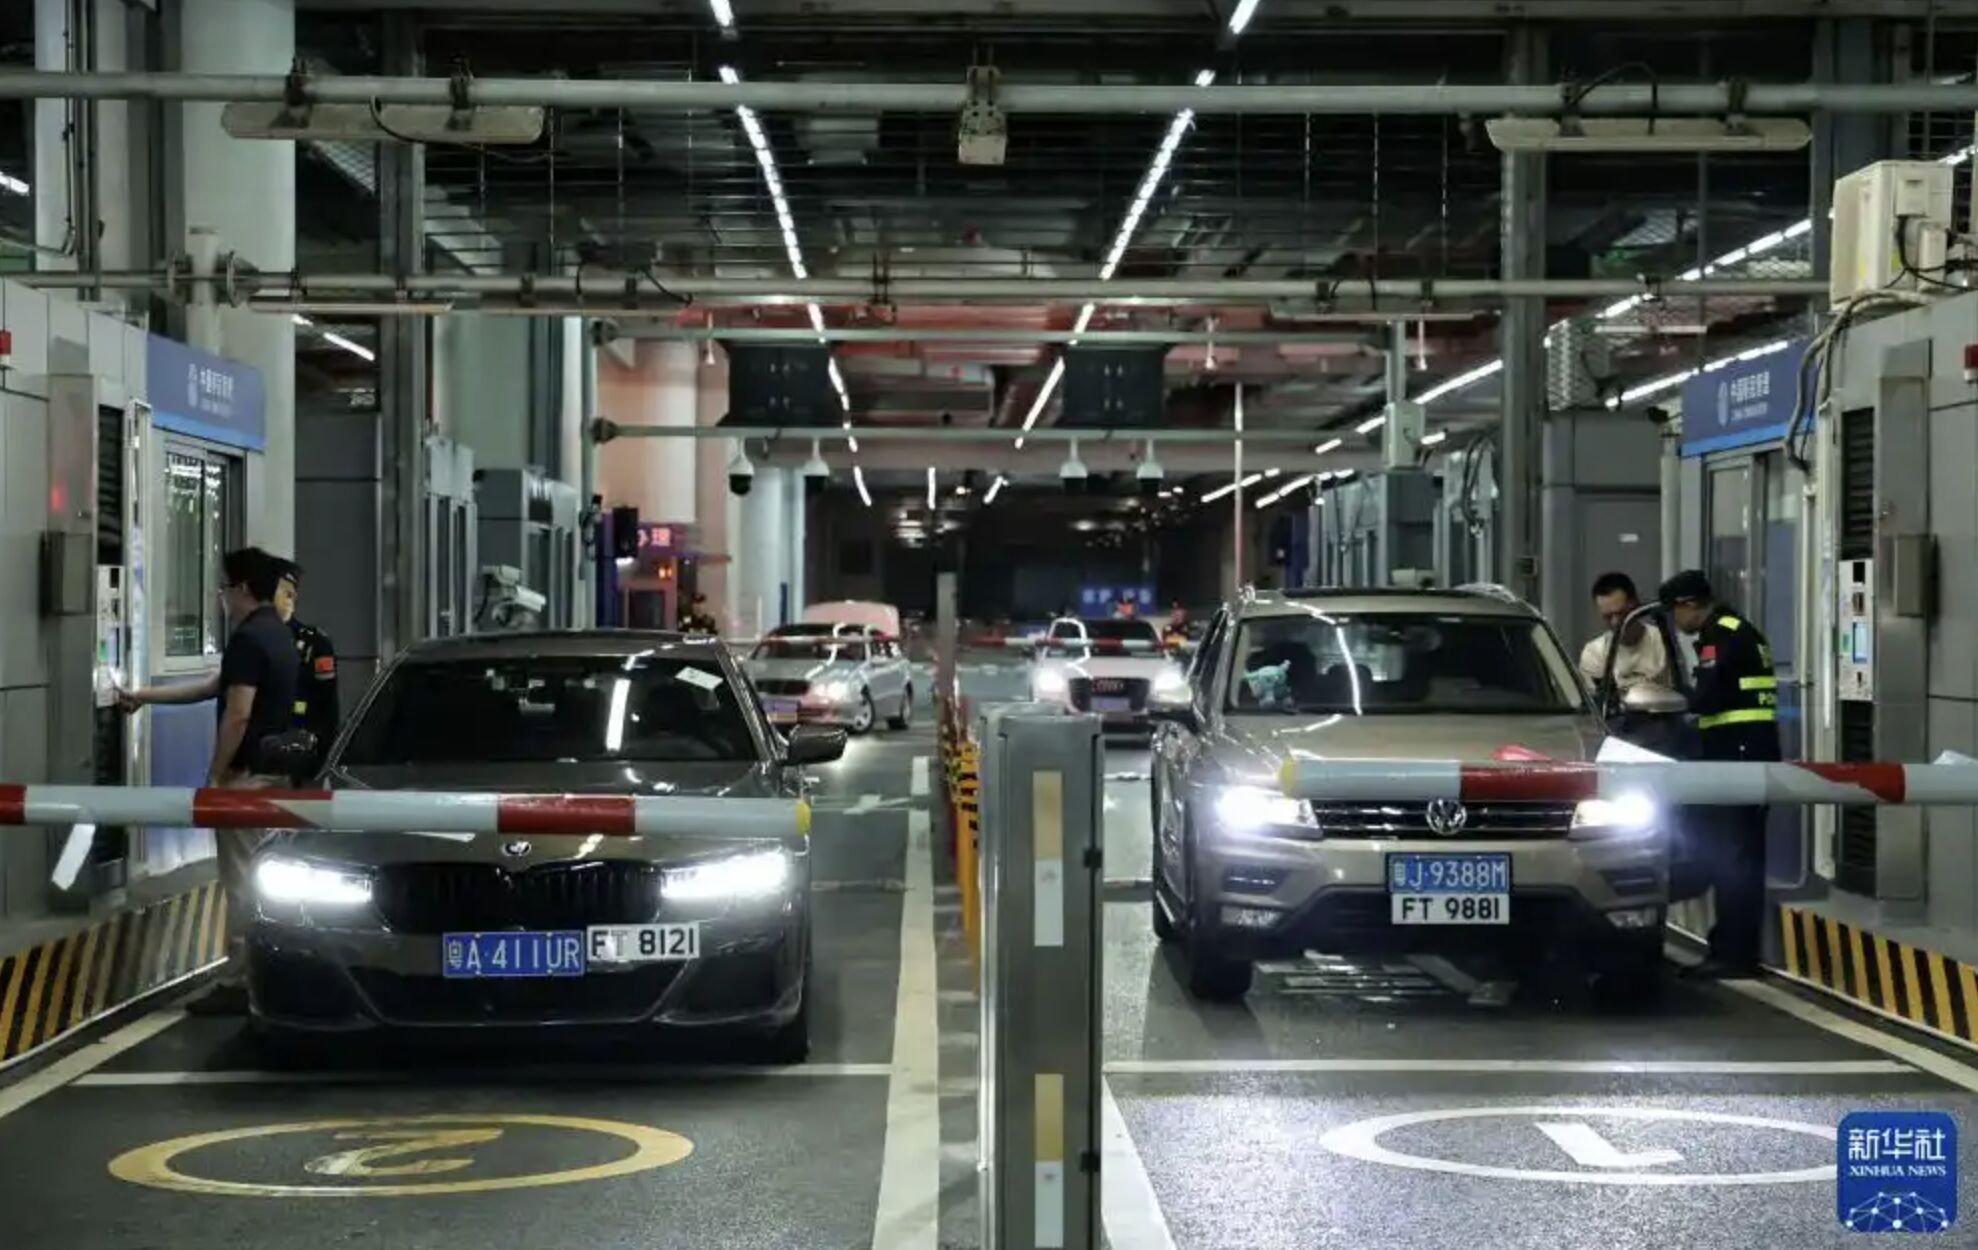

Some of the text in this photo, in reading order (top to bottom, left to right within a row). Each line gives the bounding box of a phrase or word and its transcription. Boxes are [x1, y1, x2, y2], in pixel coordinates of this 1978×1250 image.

[1402, 897, 1500, 920] FT 9881
[638, 928, 695, 956] 8121
